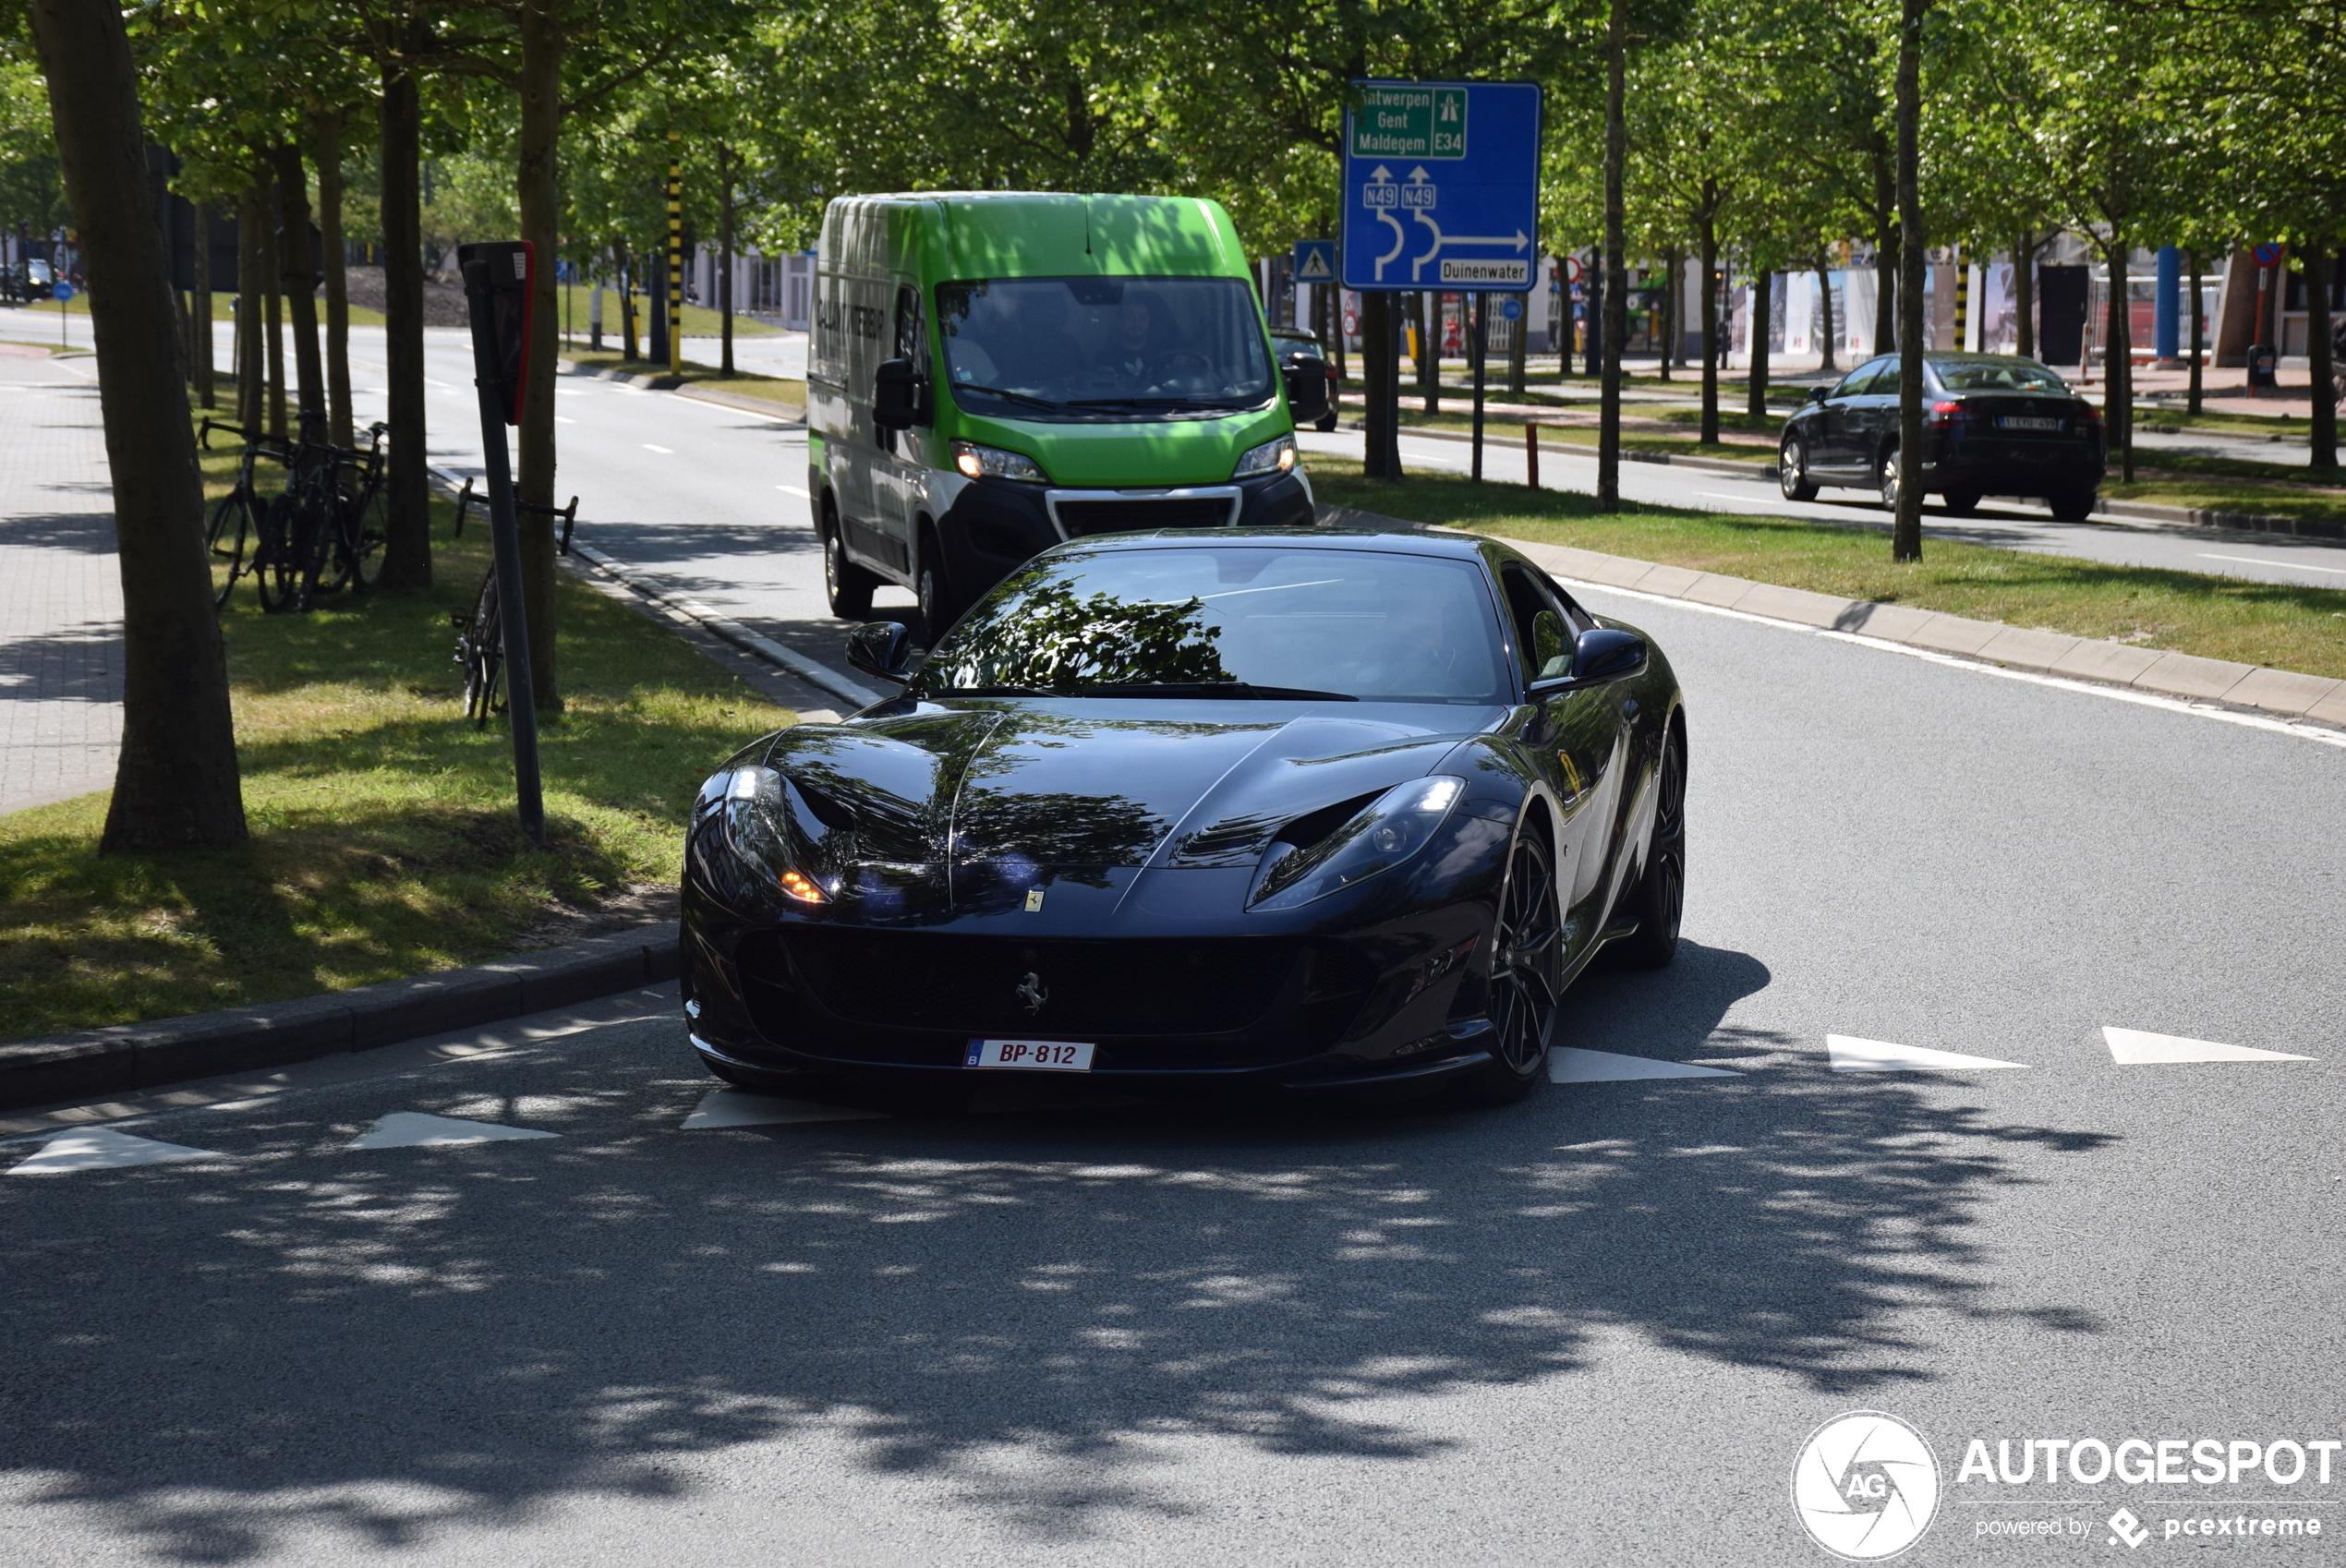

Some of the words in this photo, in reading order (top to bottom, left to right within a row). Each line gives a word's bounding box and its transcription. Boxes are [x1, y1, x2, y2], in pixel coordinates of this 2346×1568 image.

[1377, 111, 1409, 128] Gent
[1359, 133, 1425, 154] Maldegem
[1434, 134, 1462, 151] E34
[1367, 187, 1395, 205] N49
[1404, 188, 1433, 206] N49
[1443, 262, 1525, 279] Duinenwater
[967, 1055, 977, 1066] B
[999, 1043, 1076, 1064] BP-812
